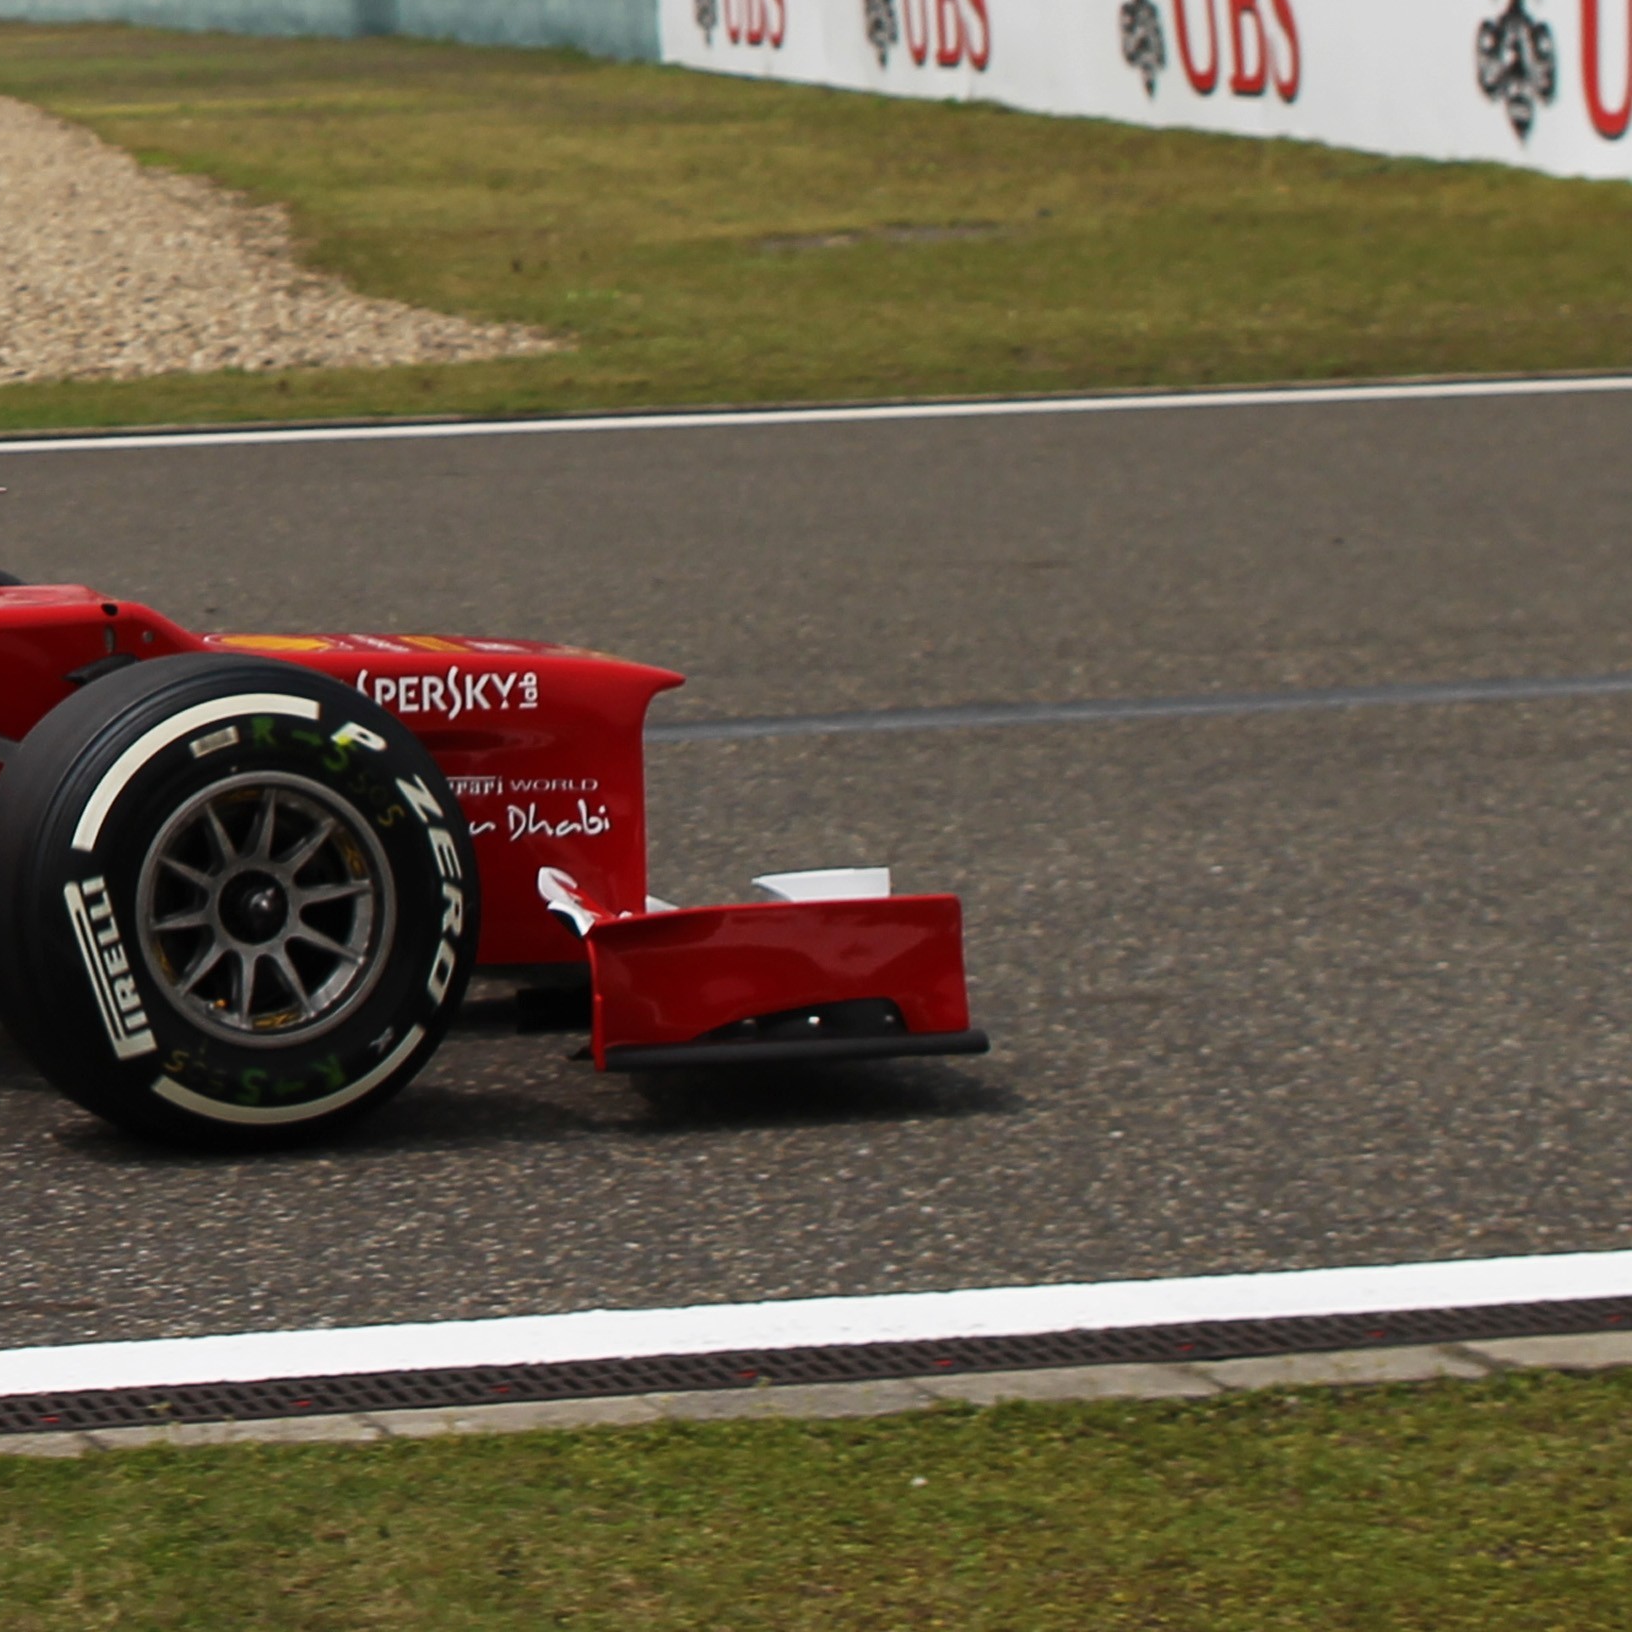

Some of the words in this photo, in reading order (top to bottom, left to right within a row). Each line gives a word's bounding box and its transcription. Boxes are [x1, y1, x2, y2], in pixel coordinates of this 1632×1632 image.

[507, 798, 611, 843] Dhabi
[510, 778, 598, 792] WORLD
[395, 773, 464, 1008] ZERO
[63, 874, 159, 1060] PIRELLI
